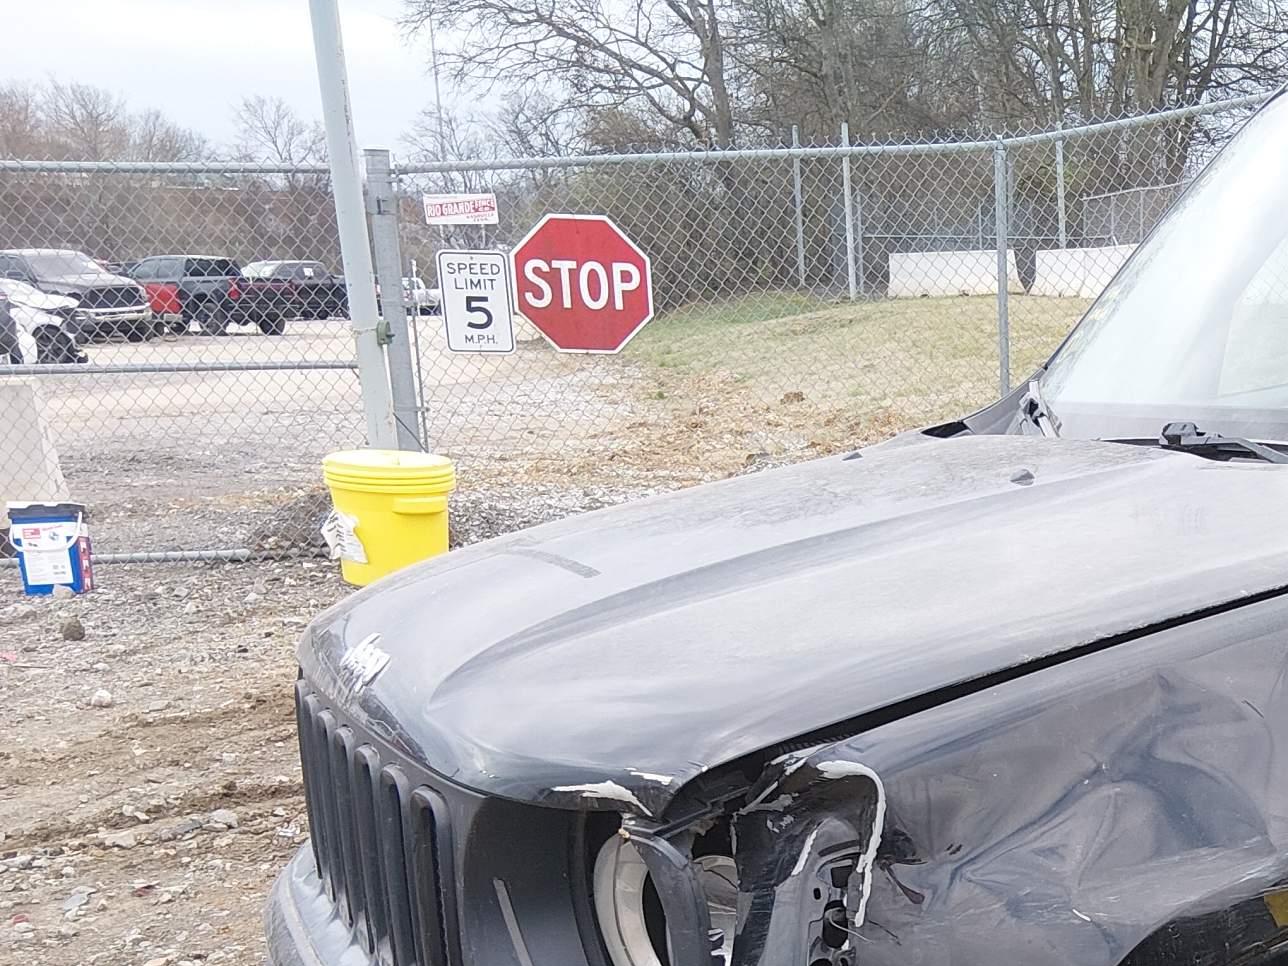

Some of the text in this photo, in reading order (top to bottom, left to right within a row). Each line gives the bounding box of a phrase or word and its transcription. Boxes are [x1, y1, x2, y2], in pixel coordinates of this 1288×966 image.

[427, 205, 442, 218] RIO
[442, 201, 475, 215] GRANDE
[446, 262, 501, 275] SPEED
[454, 278, 497, 290] LIMIT
[523, 258, 641, 311] STOP
[465, 295, 493, 330] 5
[464, 334, 498, 344] M.P.H.
